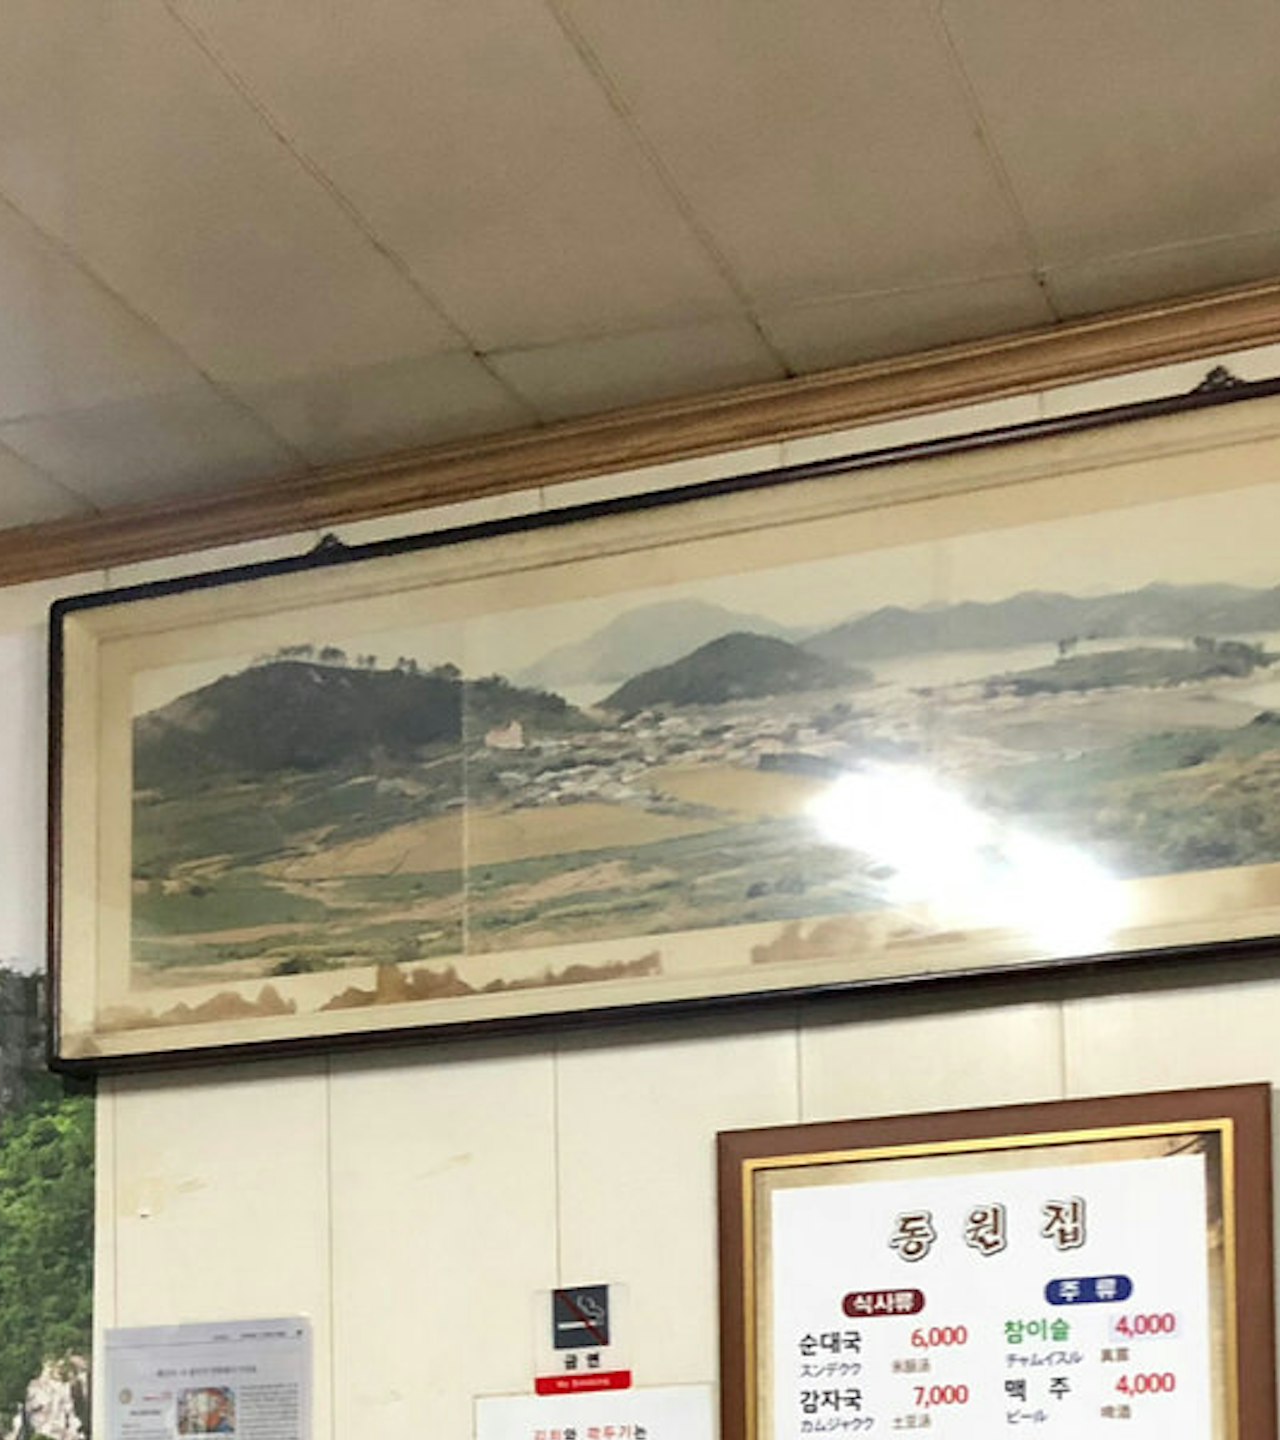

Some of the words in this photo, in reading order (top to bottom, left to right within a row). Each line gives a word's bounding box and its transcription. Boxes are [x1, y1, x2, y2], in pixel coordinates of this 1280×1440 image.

[853, 1291, 915, 1313] 식사류
[799, 1331, 862, 1357] 순대국
[911, 1325, 968, 1349] 6,000
[1004, 1317, 1070, 1344] 참이슬
[1115, 1313, 1175, 1337] 4,000
[1115, 1373, 1175, 1398] 4,000
[800, 1388, 863, 1415] 감자국
[914, 1385, 969, 1408] 7,000
[1006, 1410, 1048, 1425] ビール
[587, 1425, 647, 1440] 깍두기는
